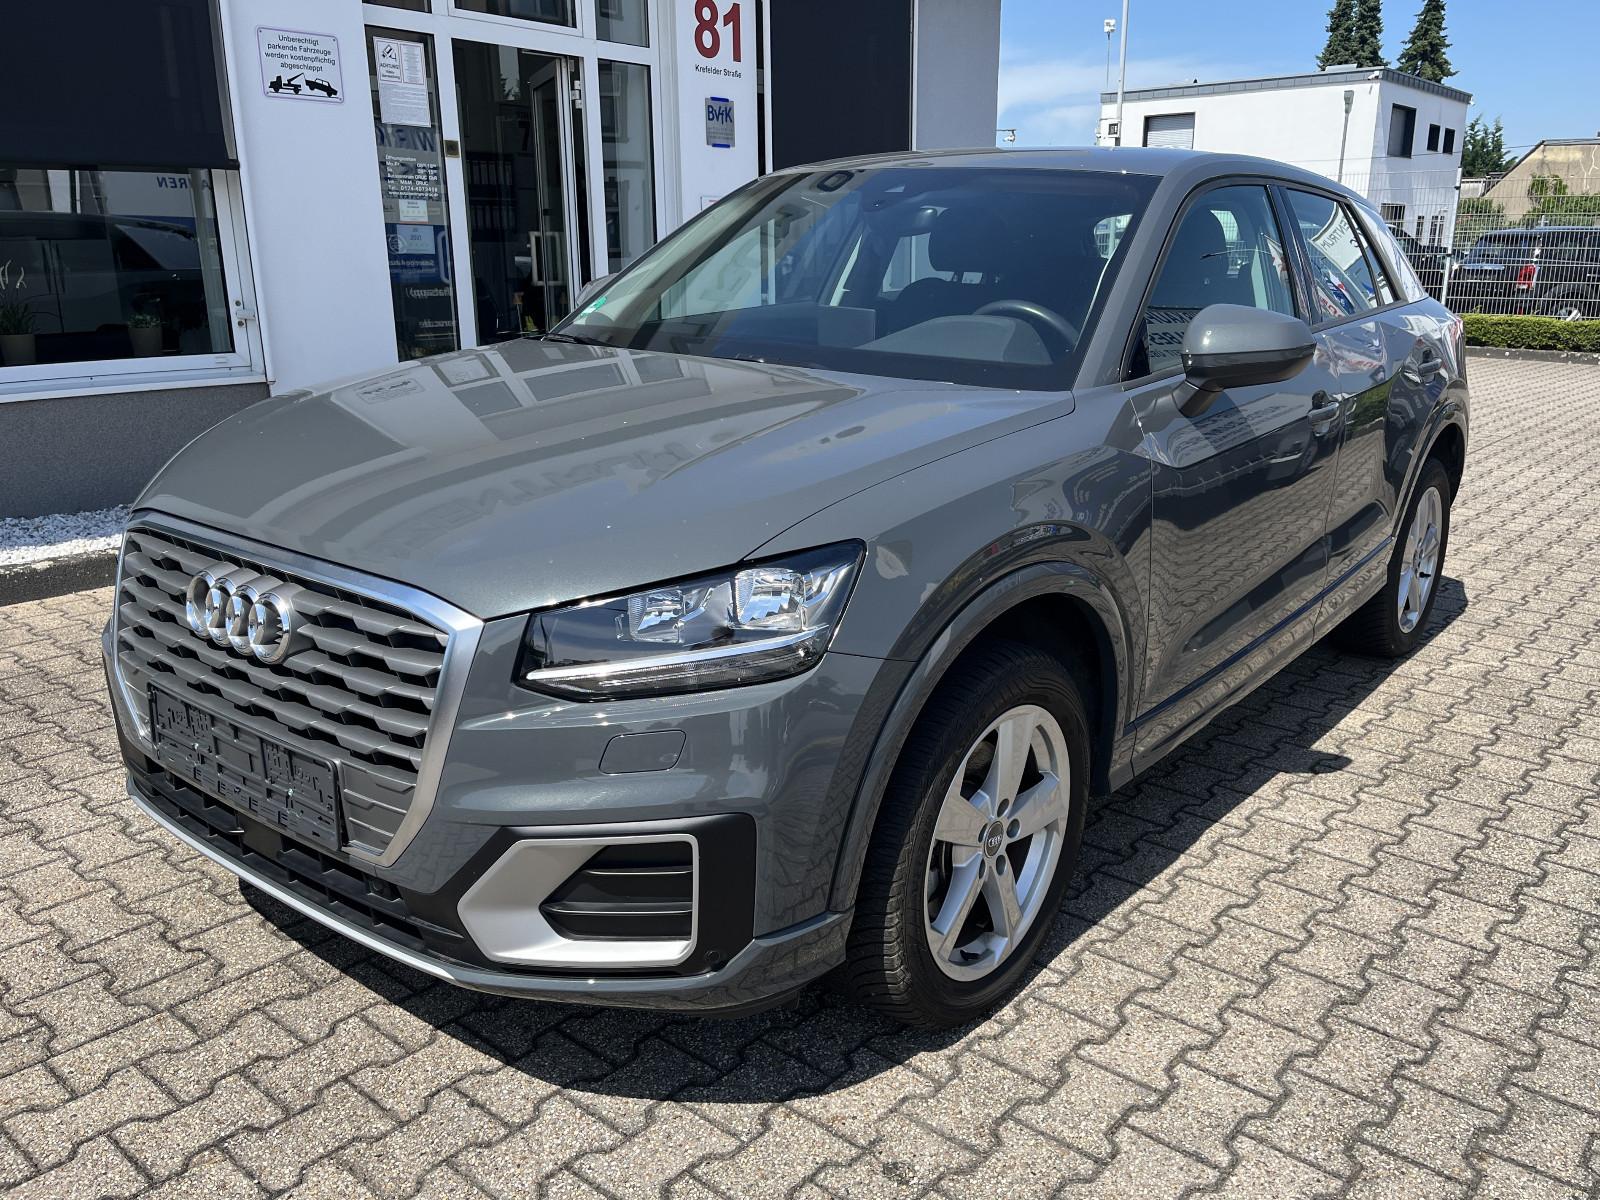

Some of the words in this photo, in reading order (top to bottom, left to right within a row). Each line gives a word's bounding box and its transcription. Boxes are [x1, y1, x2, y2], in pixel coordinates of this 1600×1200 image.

[694, 0, 741, 62] 81
[278, 34, 319, 46] Unberechtigt
[267, 43, 298, 52] parkende
[299, 45, 332, 56] Fahrzeuge
[264, 51, 289, 60] werden
[289, 53, 336, 66] kostenpflichtig
[280, 61, 323, 72] abgeschleppt
[695, 64, 722, 75] Krefelder
[723, 69, 742, 78] Straße
